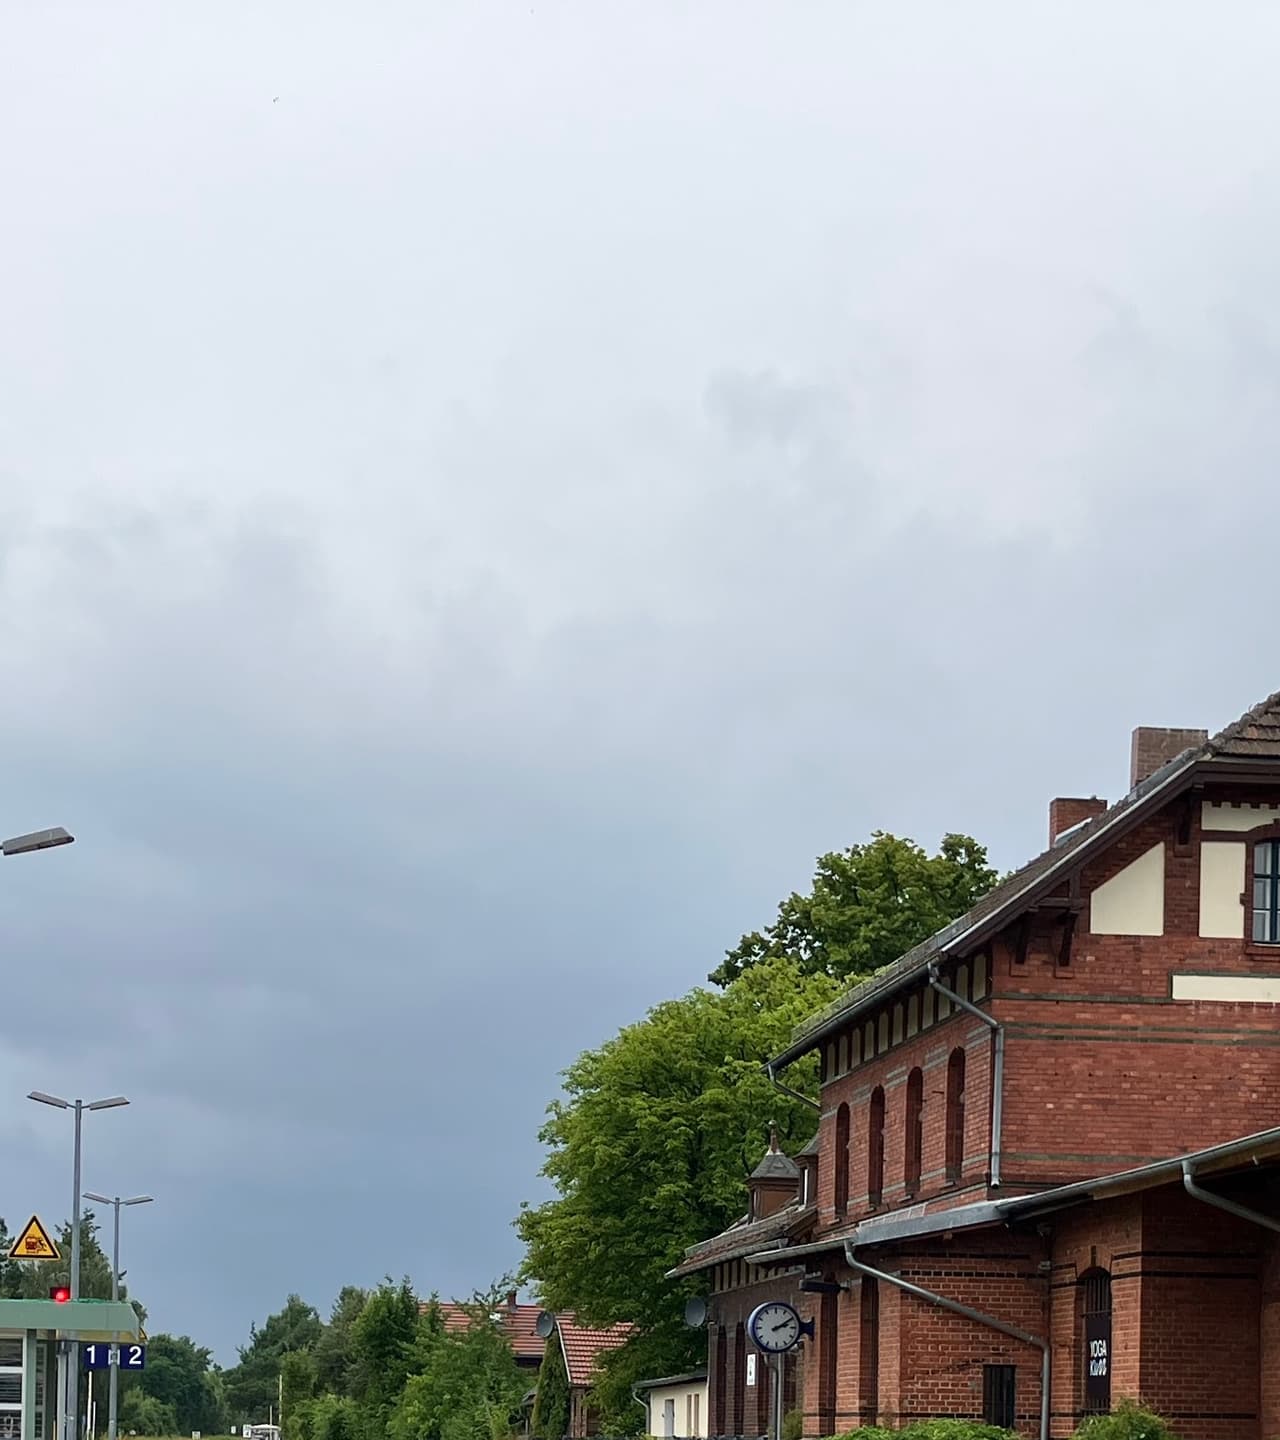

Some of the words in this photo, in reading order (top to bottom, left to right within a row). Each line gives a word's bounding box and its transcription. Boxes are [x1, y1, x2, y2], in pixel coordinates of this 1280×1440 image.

[86, 1345, 96, 1364] 1
[128, 1345, 142, 1365] 2
[1089, 1339, 1108, 1358] YOGA
